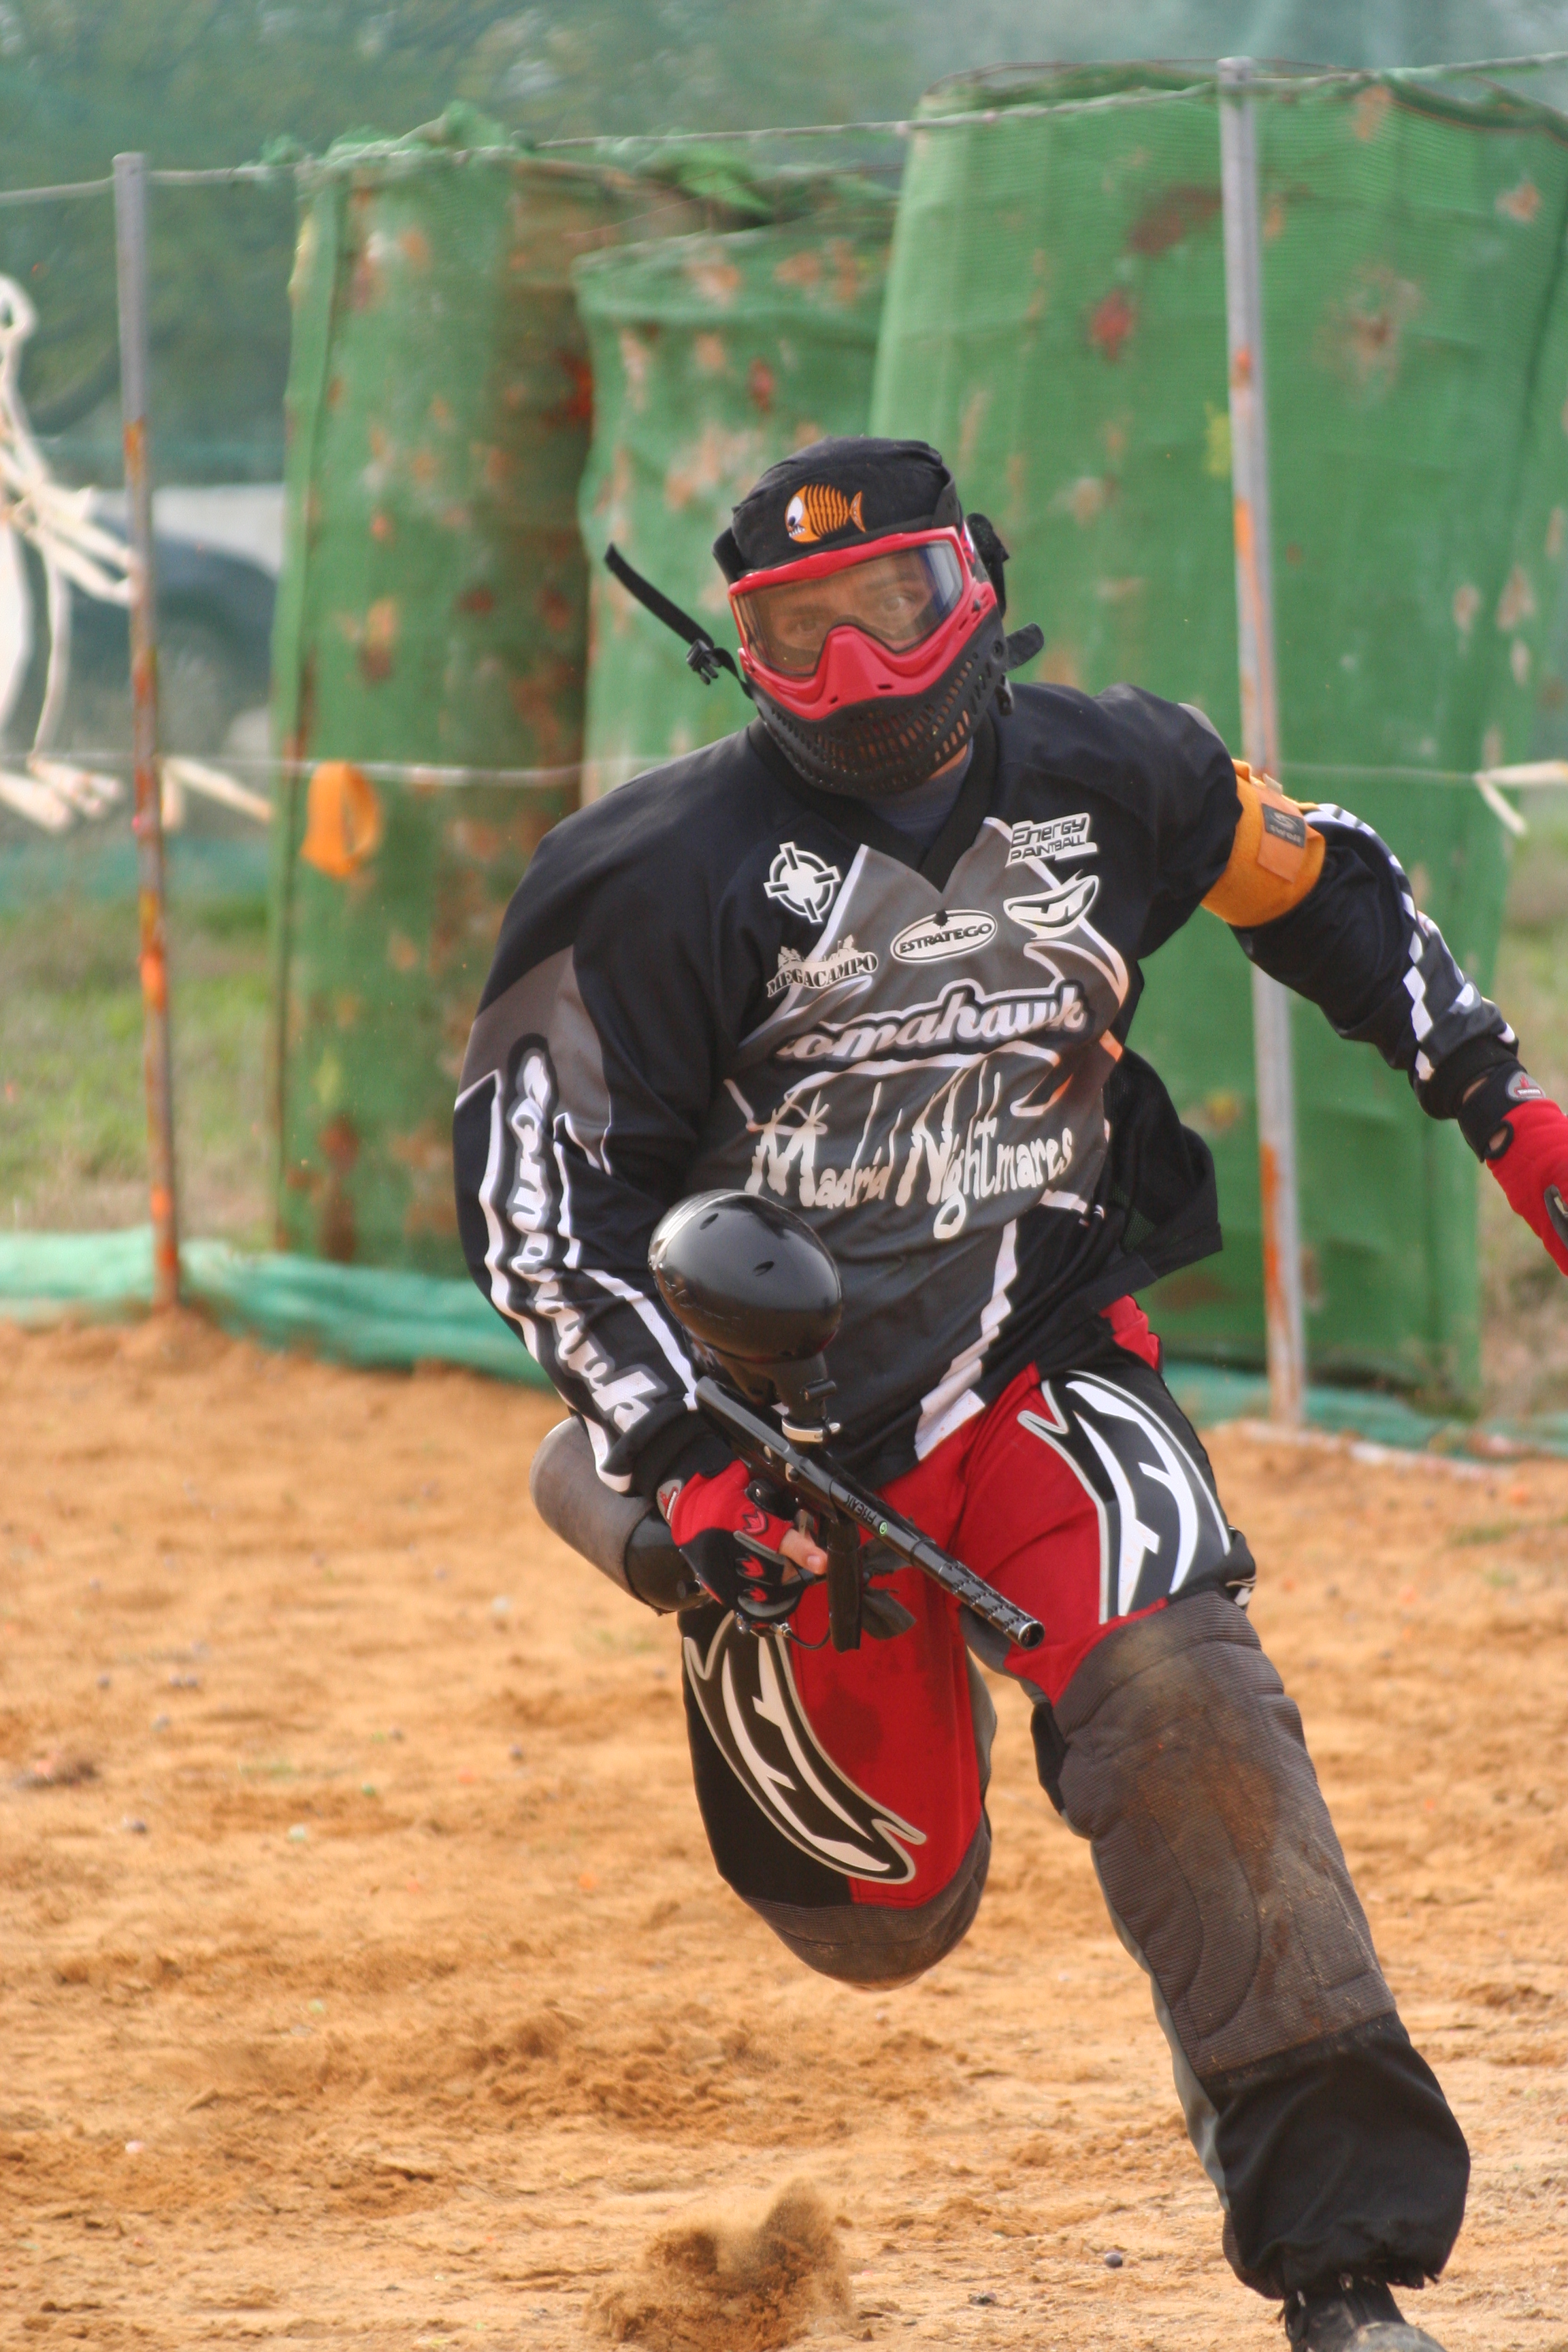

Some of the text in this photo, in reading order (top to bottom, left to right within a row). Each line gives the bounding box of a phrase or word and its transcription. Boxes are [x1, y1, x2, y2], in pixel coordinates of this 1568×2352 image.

[1010, 834, 1085, 862] PAINTBALL
[899, 922, 992, 954] ESTRATEGO
[767, 953, 878, 997] MEGACAMPO
[776, 986, 1085, 1059] omahawk
[744, 1081, 903, 1209] Madrid
[845, 1493, 878, 1525] FREAK
